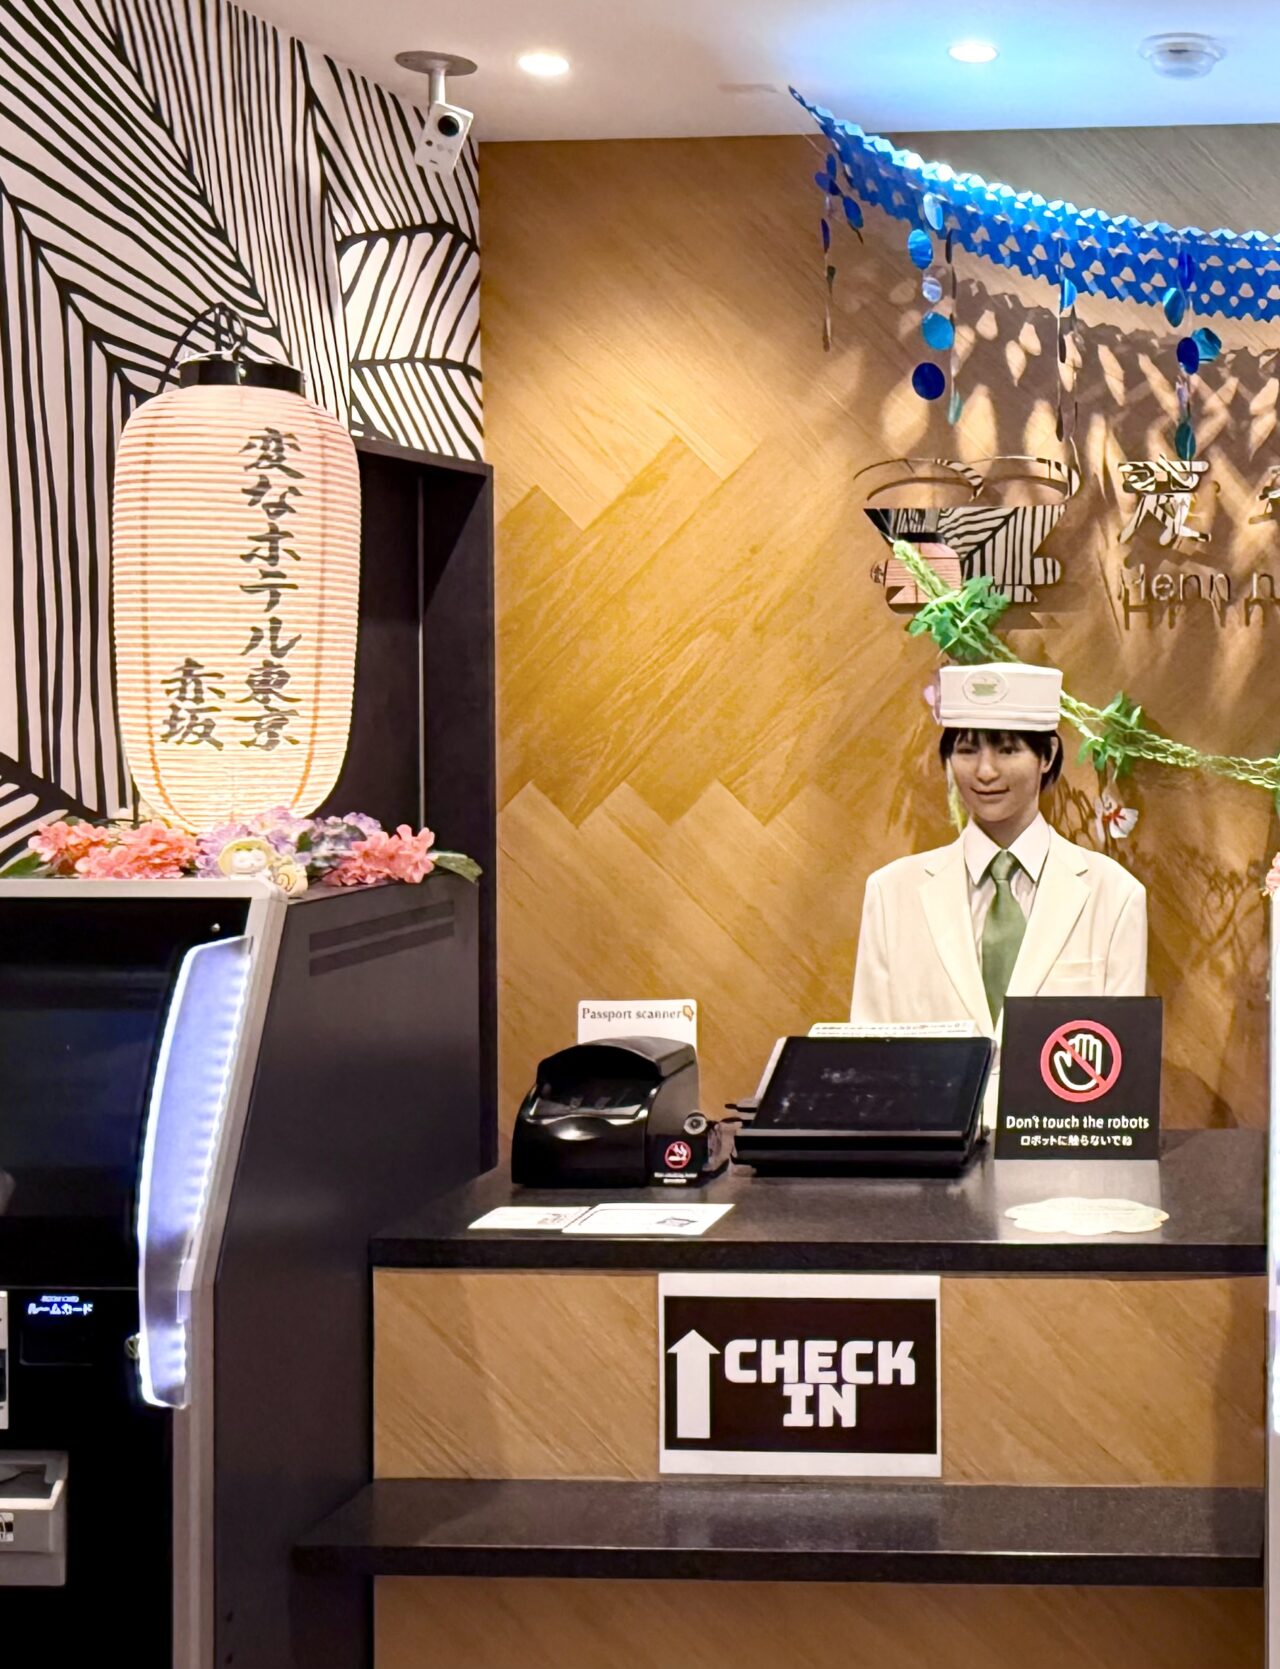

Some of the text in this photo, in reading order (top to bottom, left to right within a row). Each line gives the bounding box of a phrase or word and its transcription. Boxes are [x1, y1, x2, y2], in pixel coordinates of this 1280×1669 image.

[234, 427, 306, 752] 変なホテル東京
[160, 657, 225, 752] 赤坂
[582, 1007, 682, 1022] Passport scanner
[1006, 1115, 1150, 1129] Don't touch the robots
[724, 1339, 916, 1385] CHECK
[783, 1383, 857, 1428] IN
